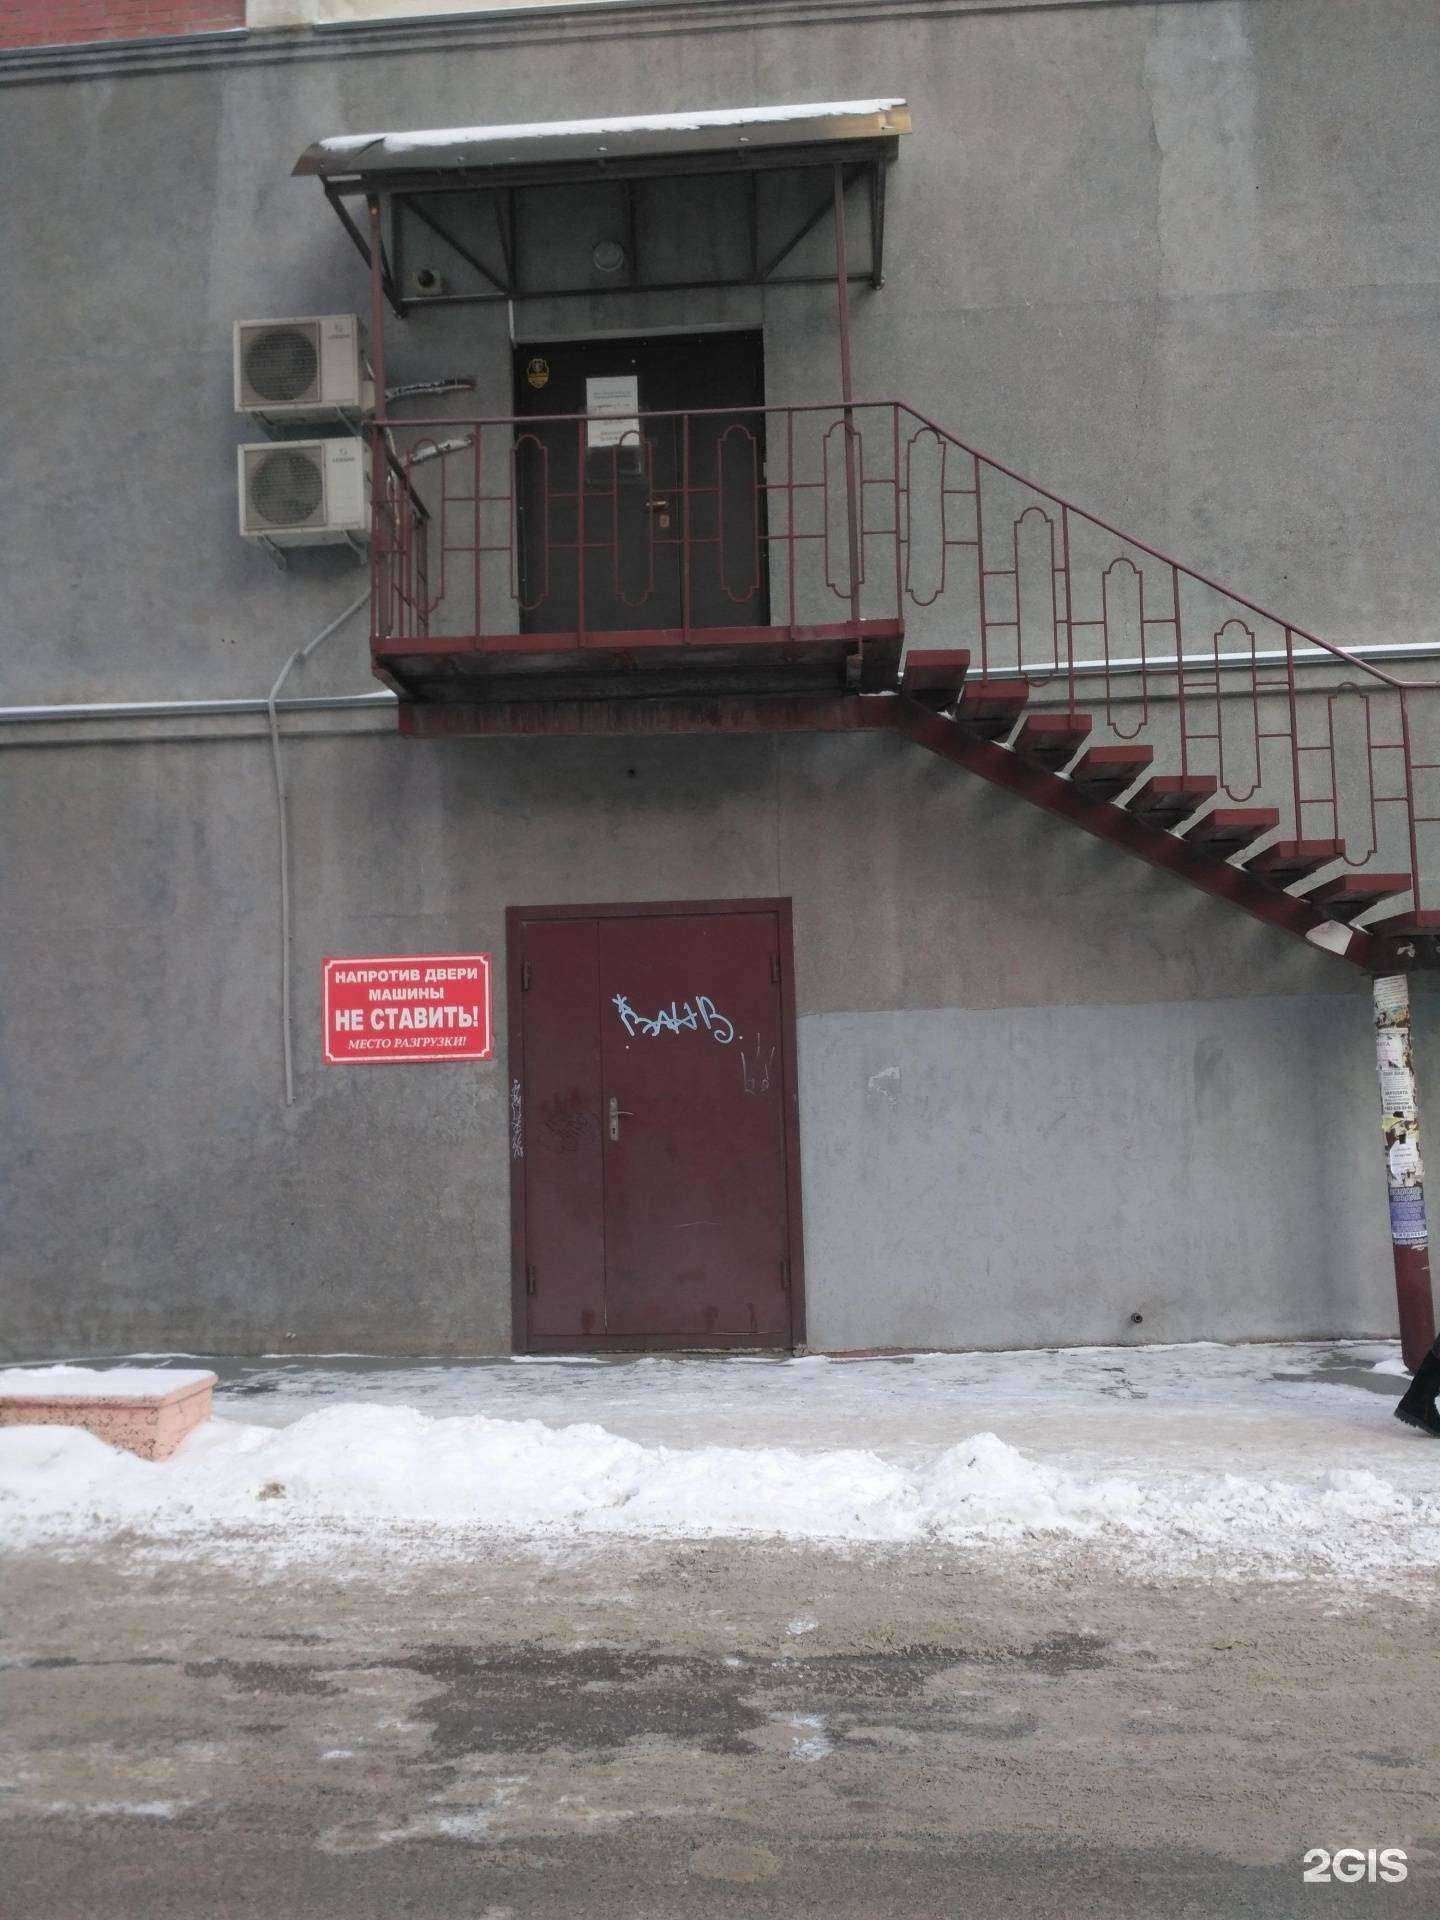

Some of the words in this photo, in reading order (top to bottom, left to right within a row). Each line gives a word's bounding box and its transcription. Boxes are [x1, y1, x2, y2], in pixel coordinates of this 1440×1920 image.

[335, 969, 420, 983] НАПРОТИВ
[425, 968, 478, 982] ДВЕРИ
[369, 987, 444, 1001] МАШИНЫ
[335, 1008, 364, 1031] НЕ
[370, 1006, 479, 1030] СТАВИТЬ!
[348, 1038, 391, 1050] МЕСТО
[394, 1036, 467, 1049] РАЗГРУЗКИ!
